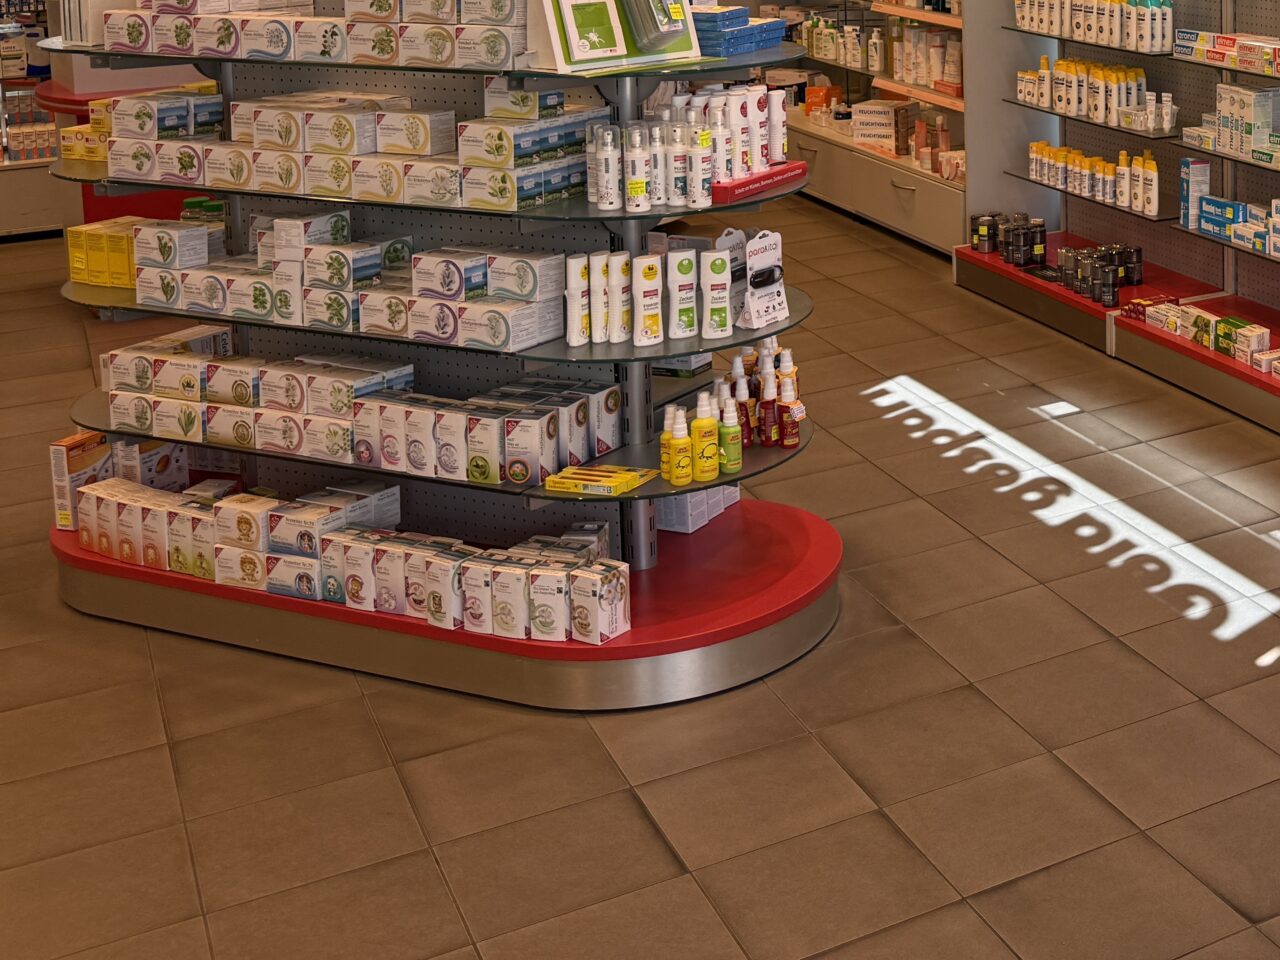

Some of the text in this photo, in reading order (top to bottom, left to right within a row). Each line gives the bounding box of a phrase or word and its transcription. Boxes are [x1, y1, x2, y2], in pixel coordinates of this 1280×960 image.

[1177, 30, 1197, 40] aronal
[1216, 36, 1235, 48] elmex
[1174, 45, 1192, 55] aronal
[1206, 51, 1225, 61] elmex
[858, 109, 890, 118] FEUCHTIGKEIT
[859, 120, 892, 129] FEUCHTIGKEIT
[860, 131, 893, 140] FEUCHTIGKEIT
[1252, 151, 1271, 162] elmex
[748, 241, 777, 259] parakito
